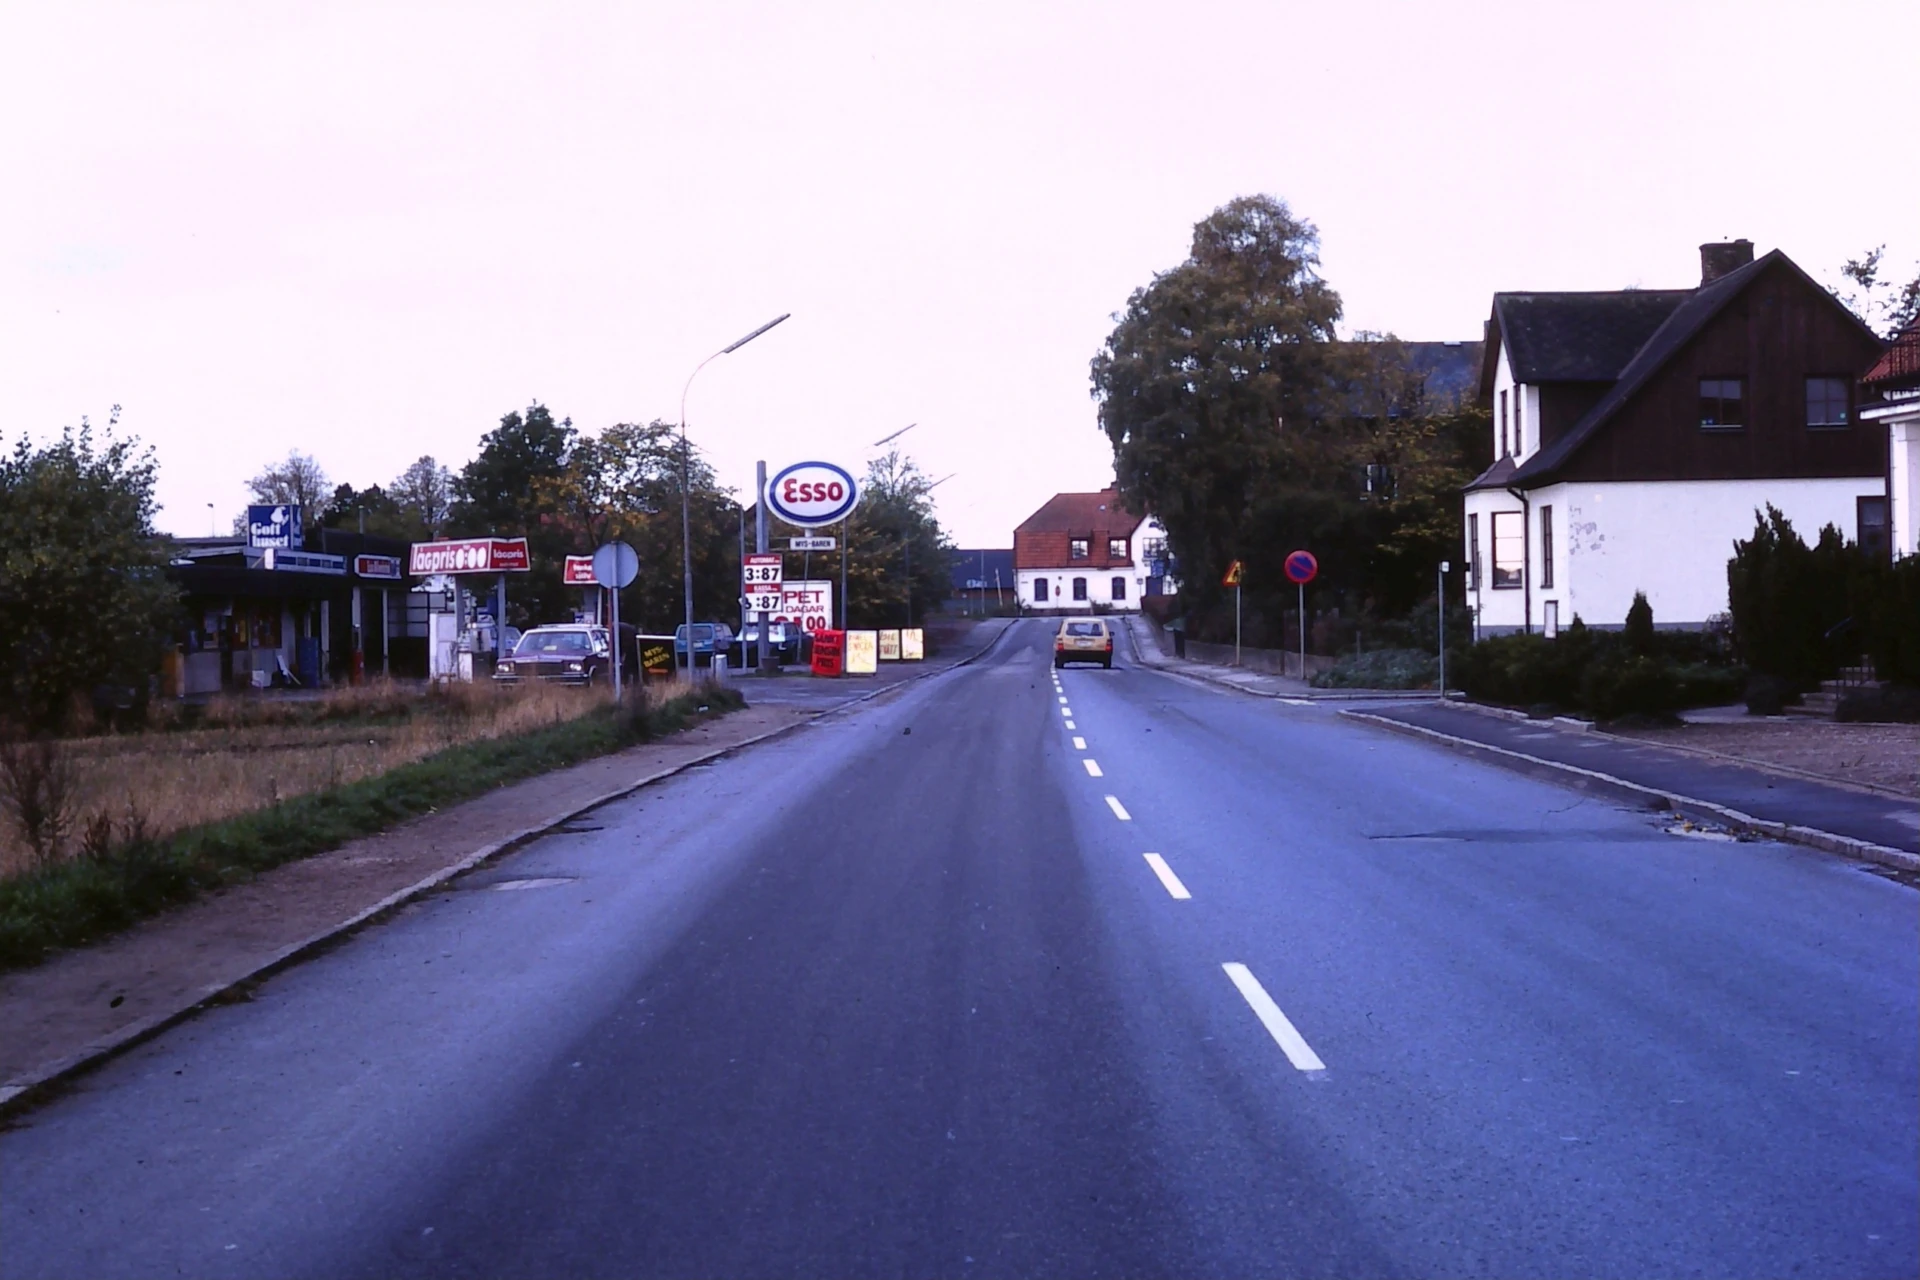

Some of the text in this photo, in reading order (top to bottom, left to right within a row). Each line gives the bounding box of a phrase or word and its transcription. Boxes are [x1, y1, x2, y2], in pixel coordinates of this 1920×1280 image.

[251, 522, 281, 536] Gott
[252, 534, 289, 548] huset
[745, 567, 780, 581] 3:87
[783, 590, 824, 604] PET
[785, 605, 824, 613] DAGAR
